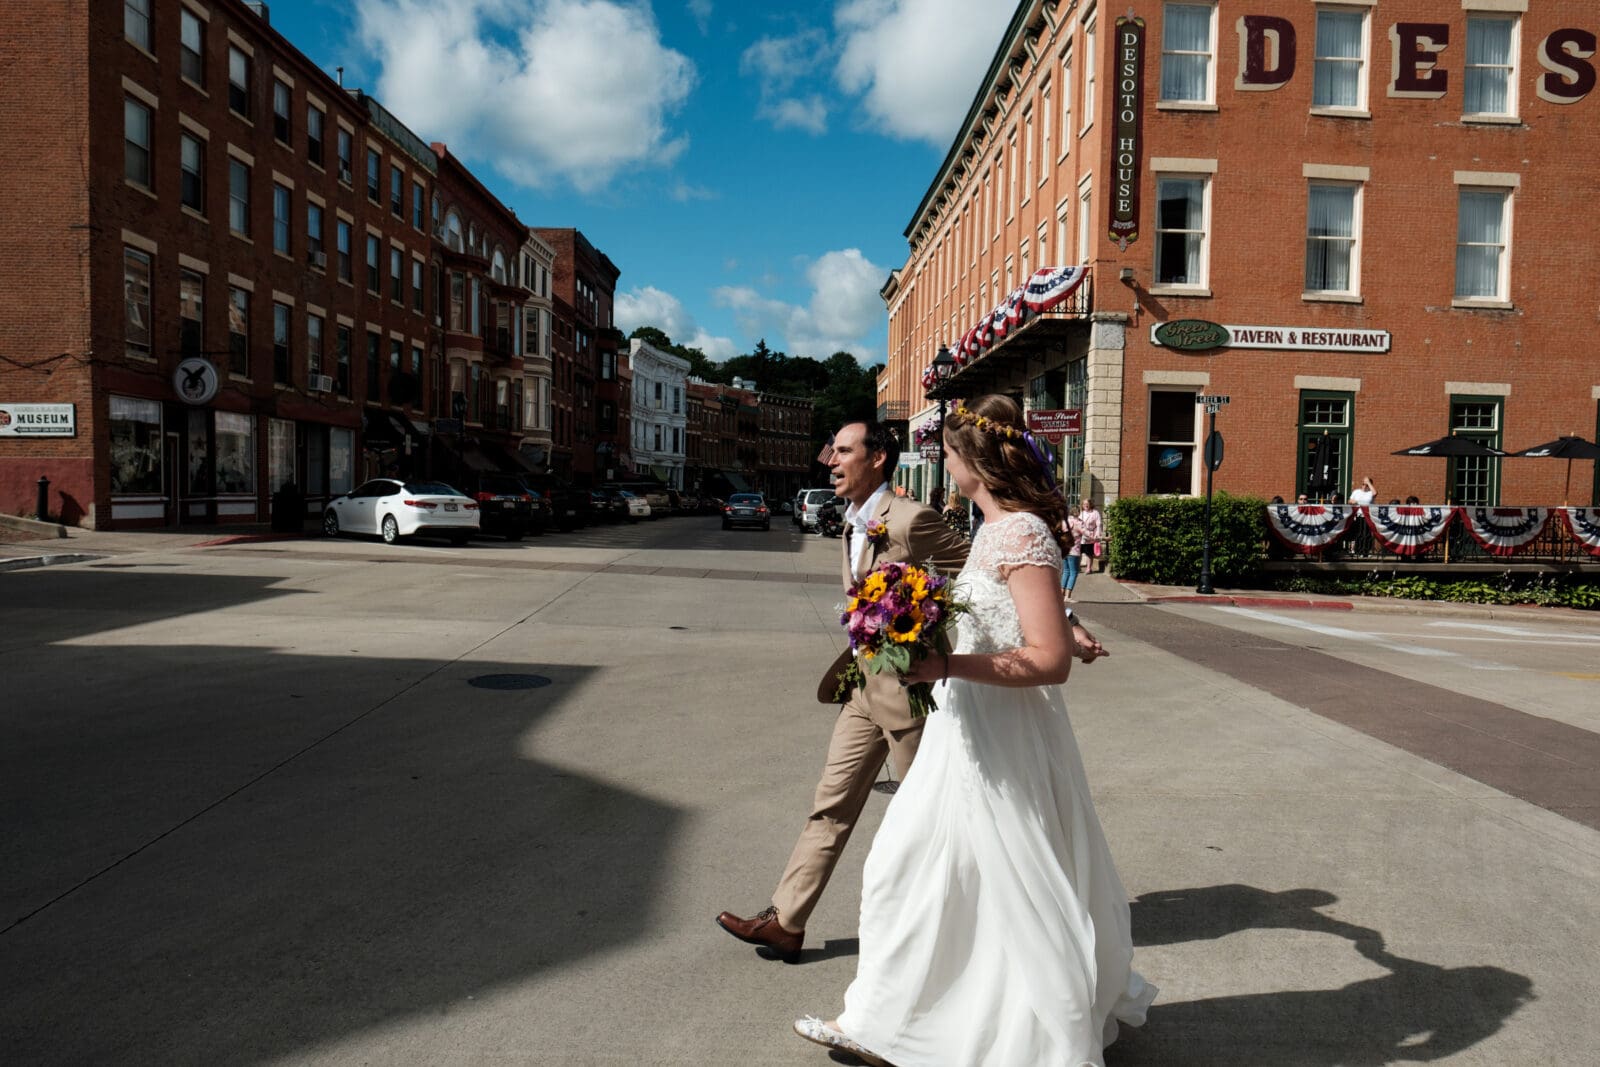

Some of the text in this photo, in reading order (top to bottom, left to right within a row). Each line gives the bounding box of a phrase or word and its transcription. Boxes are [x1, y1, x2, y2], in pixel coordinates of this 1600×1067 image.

[1119, 32, 1138, 212] DESOTO HOUSE
[1167, 321, 1208, 336] Green
[1171, 332, 1218, 346] Street
[1232, 329, 1386, 347] TAVERN & RESTAURANT
[16, 413, 69, 424] MUSEUM
[1031, 411, 1079, 422] Green Street
